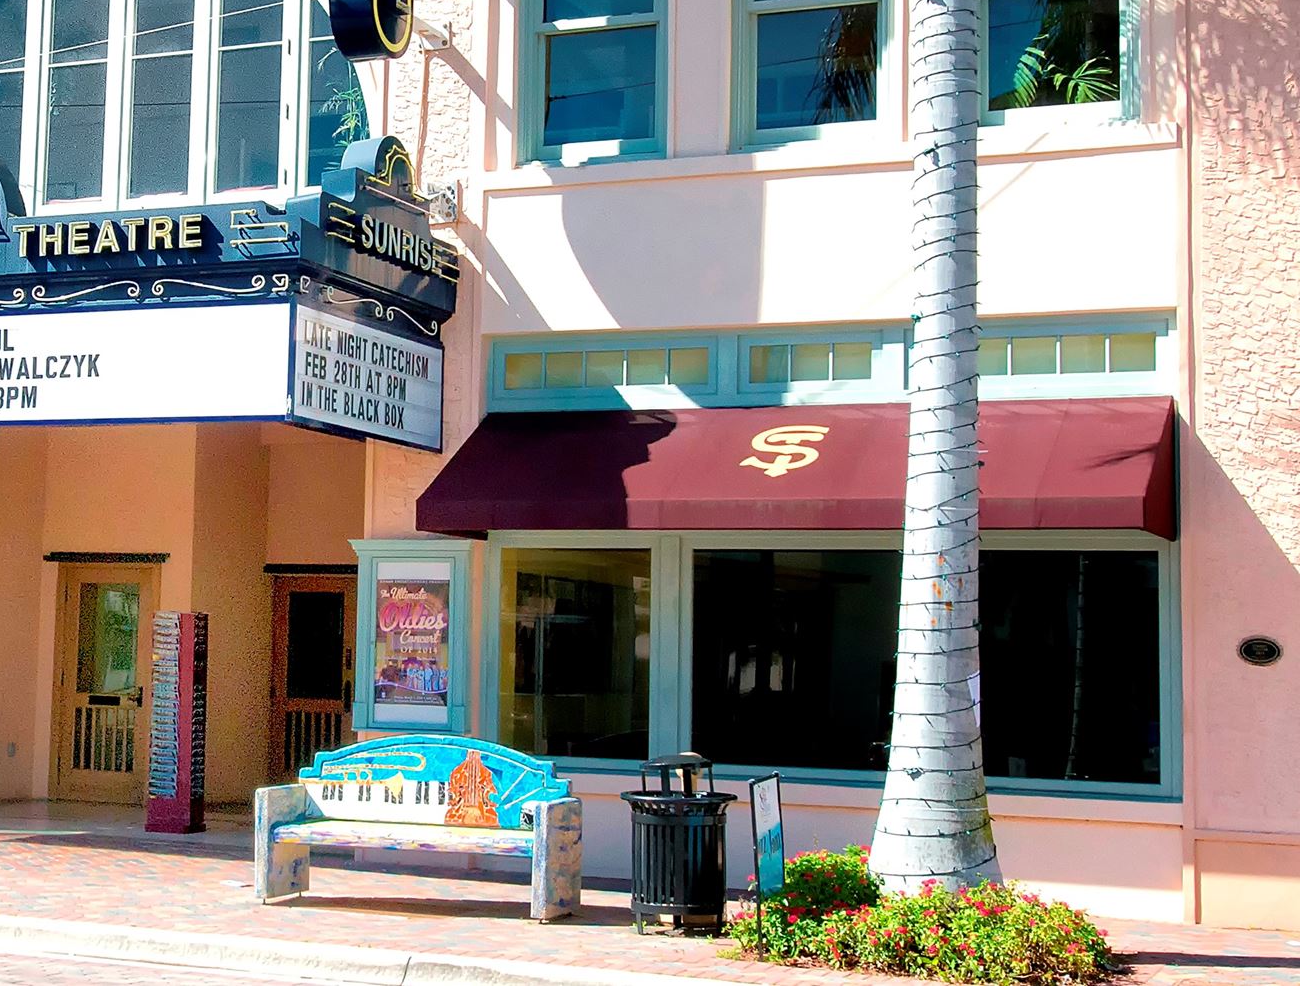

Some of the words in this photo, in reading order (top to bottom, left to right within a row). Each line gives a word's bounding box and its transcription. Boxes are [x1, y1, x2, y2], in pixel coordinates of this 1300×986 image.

[13, 214, 202, 258] THEATRE
[362, 214, 443, 276] SUNRISE
[304, 320, 331, 352] LATE
[337, 331, 368, 361] NIGHT
[371, 341, 429, 379] CATECHISM
[305, 351, 327, 380] FEB
[334, 360, 361, 389] 28TH
[366, 369, 382, 395] AT
[386, 375, 406, 401] 8PM
[302, 381, 313, 407] IN
[318, 385, 337, 412] THE
[344, 392, 380, 423] BLACK
[384, 403, 405, 429] BOX
[390, 587, 428, 600] Ultimate
[380, 602, 447, 632] Oldies
[400, 630, 441, 644] Concert
